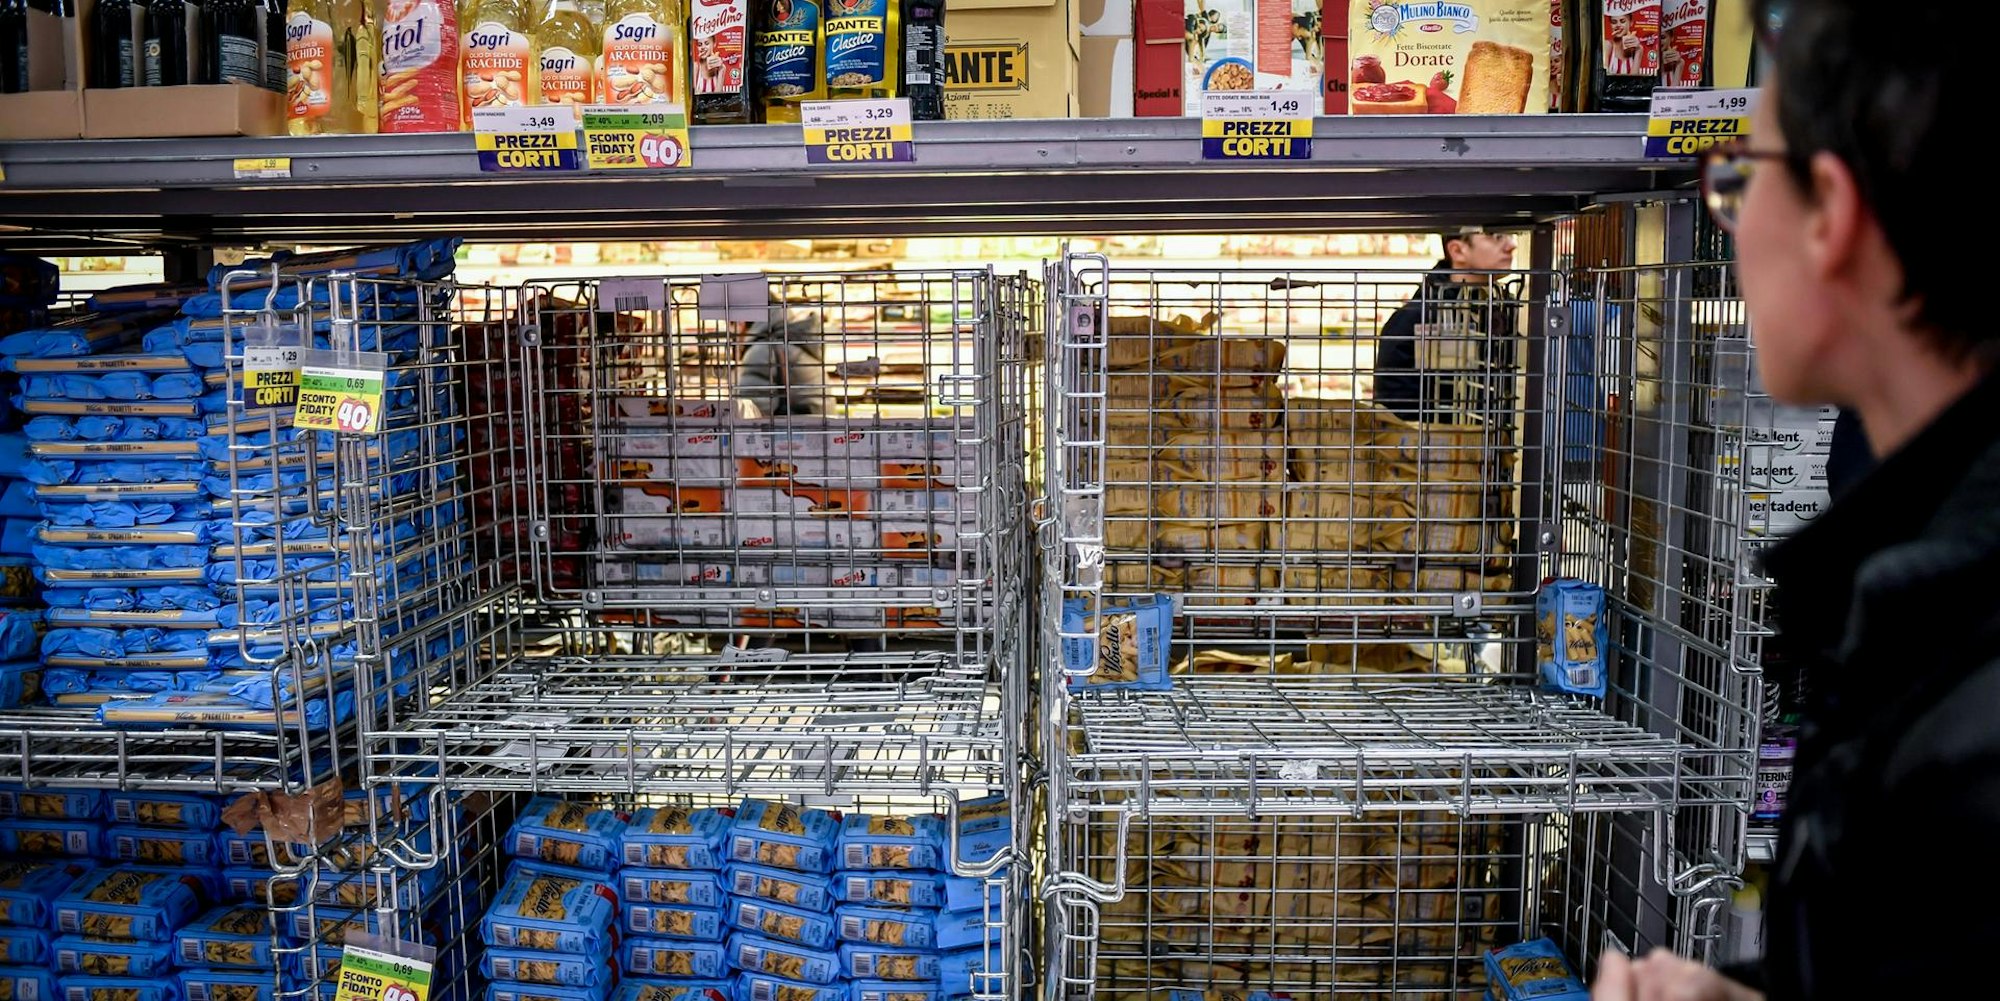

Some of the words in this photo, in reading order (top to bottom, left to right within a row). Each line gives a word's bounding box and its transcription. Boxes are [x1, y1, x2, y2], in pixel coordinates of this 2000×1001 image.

[1400, 4, 1436, 21] MULINO
[1437, 1, 1470, 19] BIANCO
[694, 9, 743, 36] FriggiAmo
[827, 19, 878, 32] DANTE
[381, 18, 424, 55] riol
[614, 24, 656, 42] Sagrì
[470, 32, 510, 50] Sagrì
[832, 32, 874, 53] Classico
[609, 51, 669, 61] ARACHIDE
[765, 45, 805, 64] Classico
[1395, 51, 1454, 67] Dorate
[944, 51, 1013, 84] ANTE
[541, 81, 586, 90] RACHIDE
[1138, 88, 1170, 99] Special
[1173, 88, 1180, 97] K
[1271, 101, 1298, 113] 1,49
[1719, 97, 1746, 109] 1,99
[642, 114, 664, 126] 2,09
[865, 108, 893, 119] 3,29
[529, 117, 555, 128] 3,49
[1224, 122, 1291, 135] PREZZI
[1670, 119, 1739, 134] PREZZI
[495, 135, 558, 148] PREZZI
[589, 133, 635, 142] SCONTO
[825, 127, 891, 142] PREZZI
[591, 144, 635, 154] FIDATY
[826, 143, 893, 161] CORTI
[1223, 138, 1291, 156] CORTI
[497, 150, 560, 168] CORTI
[282, 351, 297, 362] 1,29
[257, 372, 294, 385] PREZZI
[347, 378, 365, 389] 0,69
[255, 387, 294, 405] CORTI
[301, 394, 336, 404] SCONTO
[299, 405, 335, 415] FIDATY
[1101, 625, 1122, 674] Voiello
[535, 878, 562, 915] Voiello
[393, 963, 413, 975] 0,69
[343, 971, 382, 987] SCONTO
[341, 982, 381, 998] FIDATY
